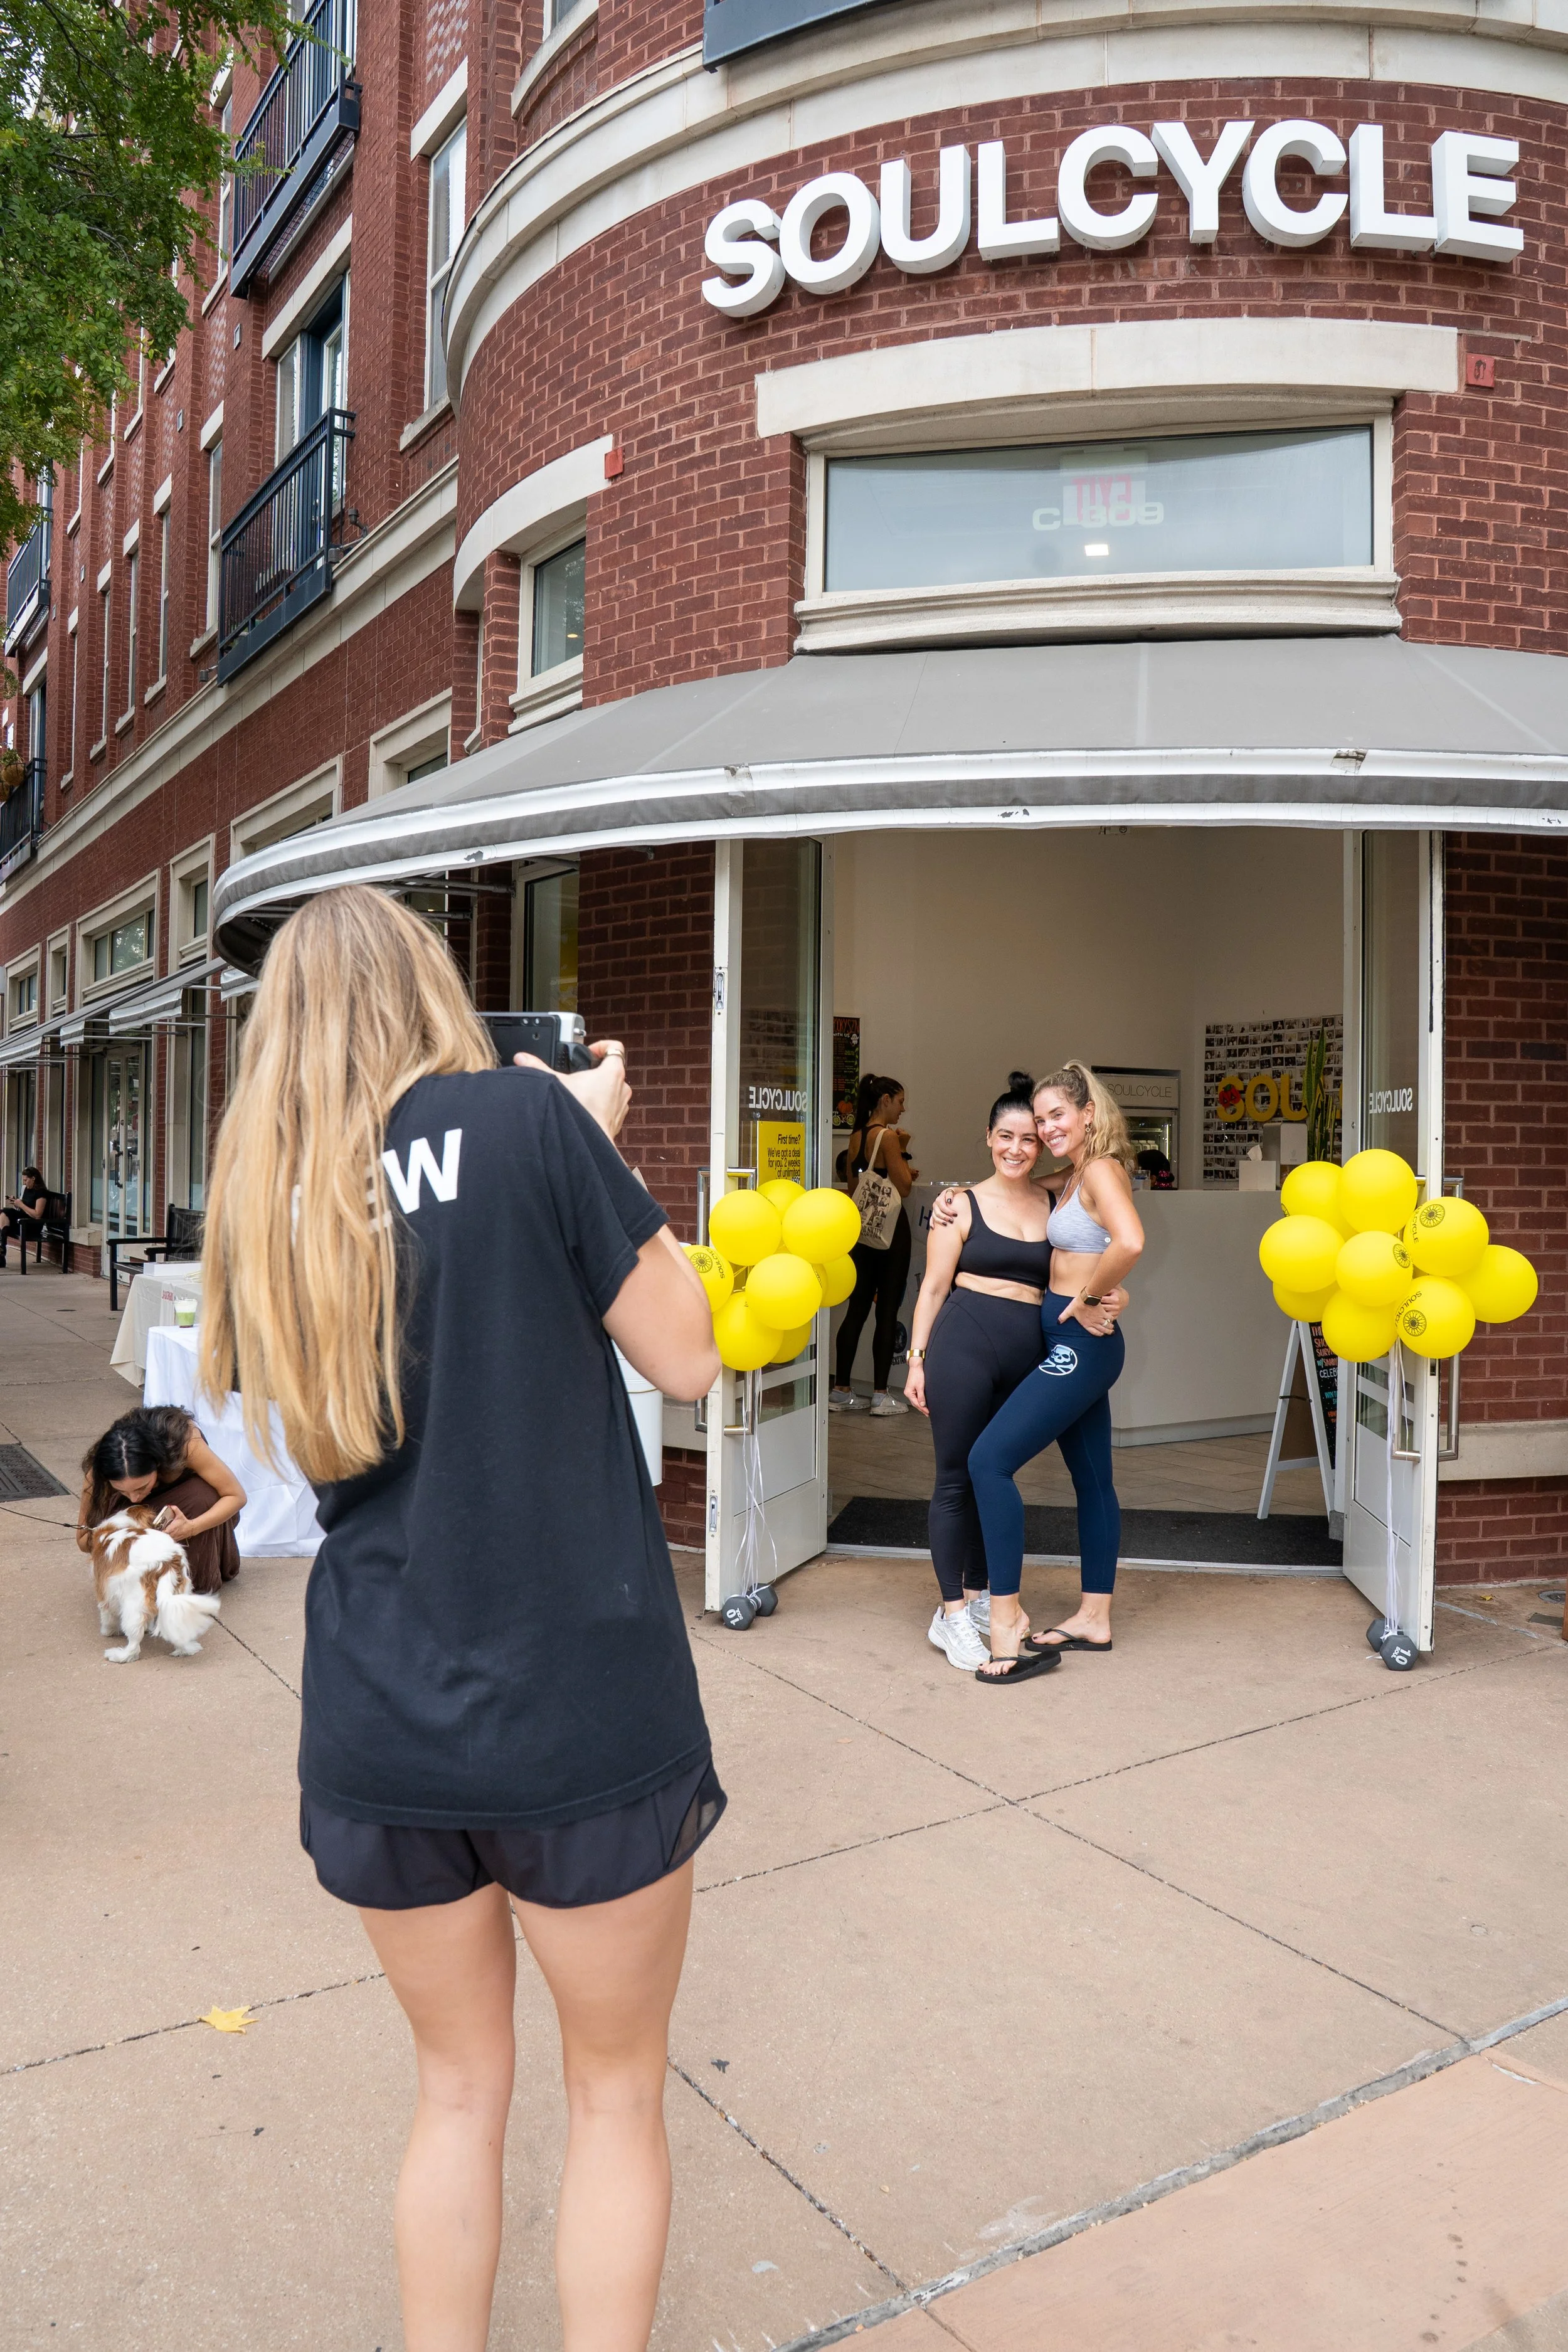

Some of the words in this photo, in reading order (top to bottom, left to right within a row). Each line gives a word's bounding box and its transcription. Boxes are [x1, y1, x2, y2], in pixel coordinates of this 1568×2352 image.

[701, 120, 1524, 318] SOULCYCLE
[1107, 1083, 1172, 1098] SOULCYCLE
[777, 1133, 788, 1145] First
[788, 1133, 801, 1145] time?
[767, 1147, 781, 1158] We've
[792, 1147, 801, 1157] deal
[787, 1158, 801, 1167] weeks
[777, 1167, 782, 1178] of
[782, 1167, 801, 1177] unlimited
[726, 1609, 740, 1626] 10
[1391, 1646, 1401, 1658] SOUL
[1395, 1649, 1411, 1665] 10
